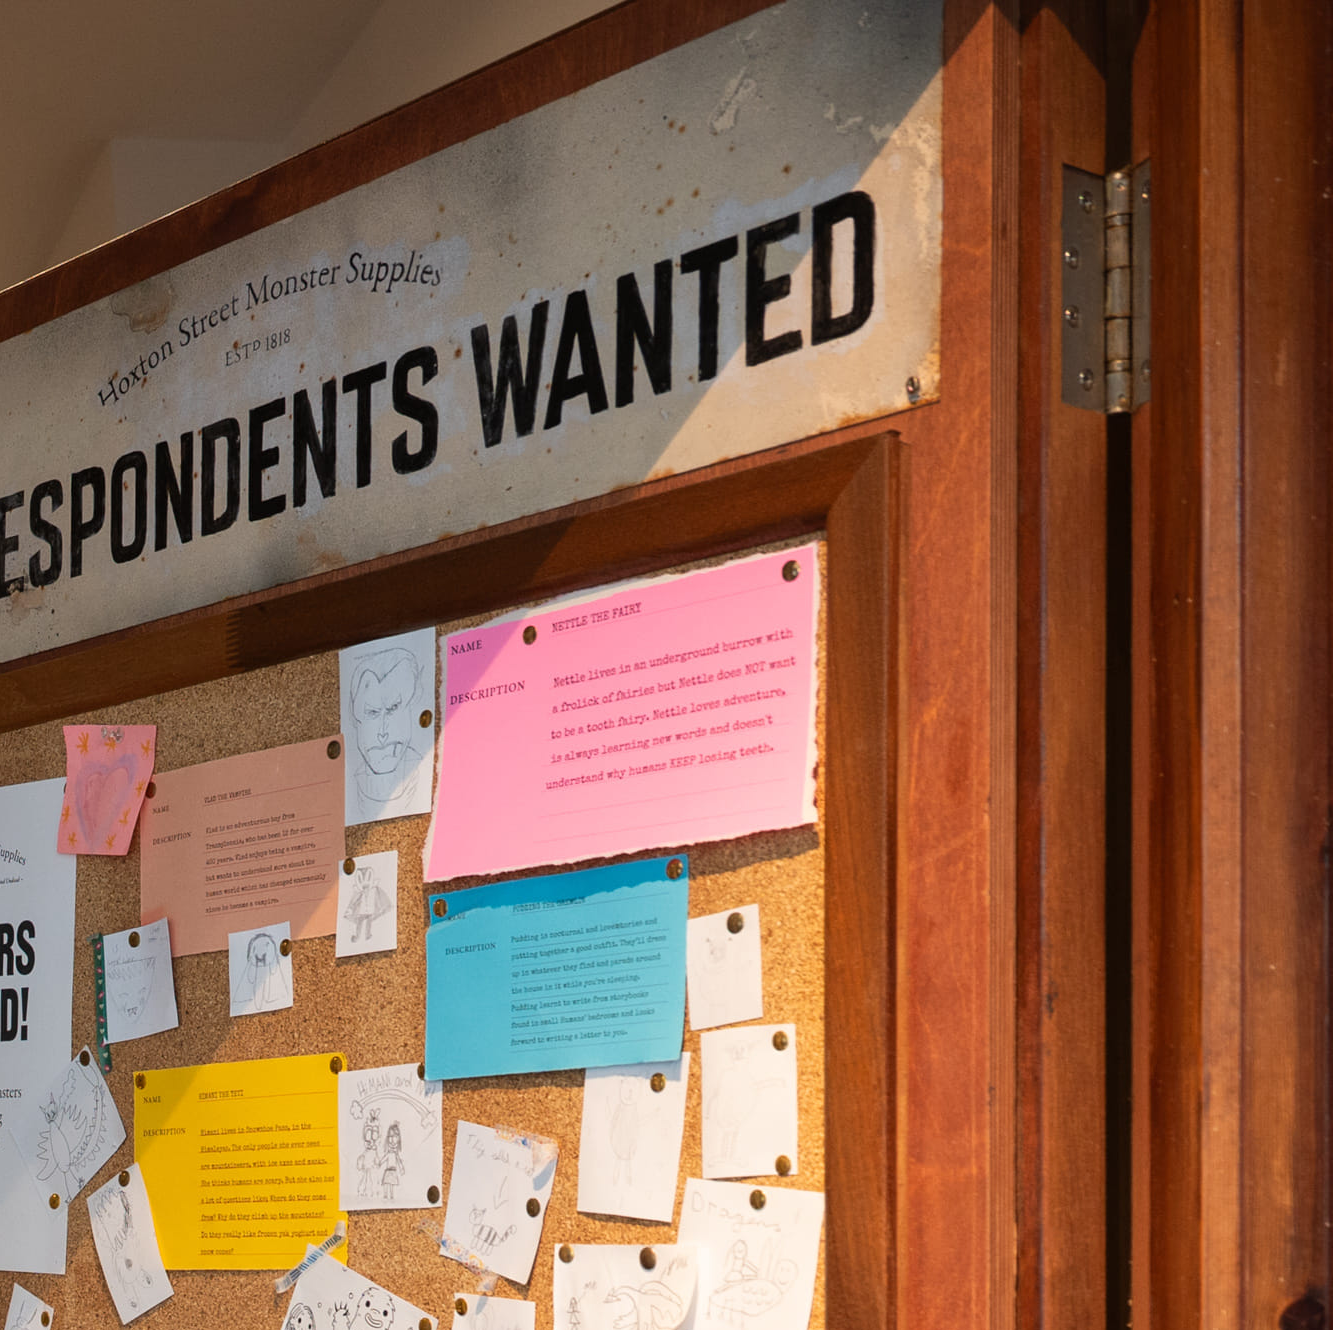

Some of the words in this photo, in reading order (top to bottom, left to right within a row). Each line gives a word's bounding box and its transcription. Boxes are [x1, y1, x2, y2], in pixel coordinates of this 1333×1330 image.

[98, 340, 173, 406] Hoxton
[179, 298, 239, 346] Street
[245, 262, 341, 311] Monster
[346, 251, 443, 293] Supplies
[471, 190, 875, 448] WANTED
[265, 329, 291, 350] 1818
[552, 613, 588, 632] NETTLE
[591, 610, 609, 623] THE
[613, 602, 641, 619] FAIRY
[451, 640, 482, 655] NAME
[553, 671, 585, 688] Nettle
[588, 666, 615, 680] lives
[616, 664, 631, 675] in
[634, 661, 646, 670] an
[649, 645, 719, 666] underground
[722, 636, 762, 653] burrow
[767, 628, 793, 642] with
[450, 680, 525, 705] DESCRIPTION
[561, 696, 599, 712] frolick
[602, 691, 615, 704] of
[615, 685, 654, 702] fairies
[658, 681, 675, 692] but
[679, 674, 713, 688] Nettle
[717, 668, 741, 680] does
[745, 661, 766, 675] NOT
[769, 656, 795, 669] want
[551, 730, 561, 740] to
[564, 727, 575, 737] be
[587, 719, 615, 732] tooth
[617, 713, 649, 728] fairy.
[653, 704, 687, 720] Nettle
[690, 700, 720, 714] loves
[723, 688, 785, 707] adventure,
[551, 753, 561, 764] is
[564, 748, 599, 762] always
[601, 738, 649, 755] learning
[653, 735, 671, 746] new
[675, 728, 707, 741] words
[709, 723, 729, 734] and
[733, 715, 773, 731] doesn't
[546, 773, 603, 790] understand
[607, 768, 626, 781] why
[629, 764, 667, 776] humans
[670, 756, 696, 769] KEEP
[699, 750, 737, 765] losing
[739, 743, 773, 757] teeth.
[153, 832, 192, 845] DESCRIPTION
[445, 942, 495, 956] DESCRIPTION
[143, 1128, 186, 1137] DESCRIPTION
